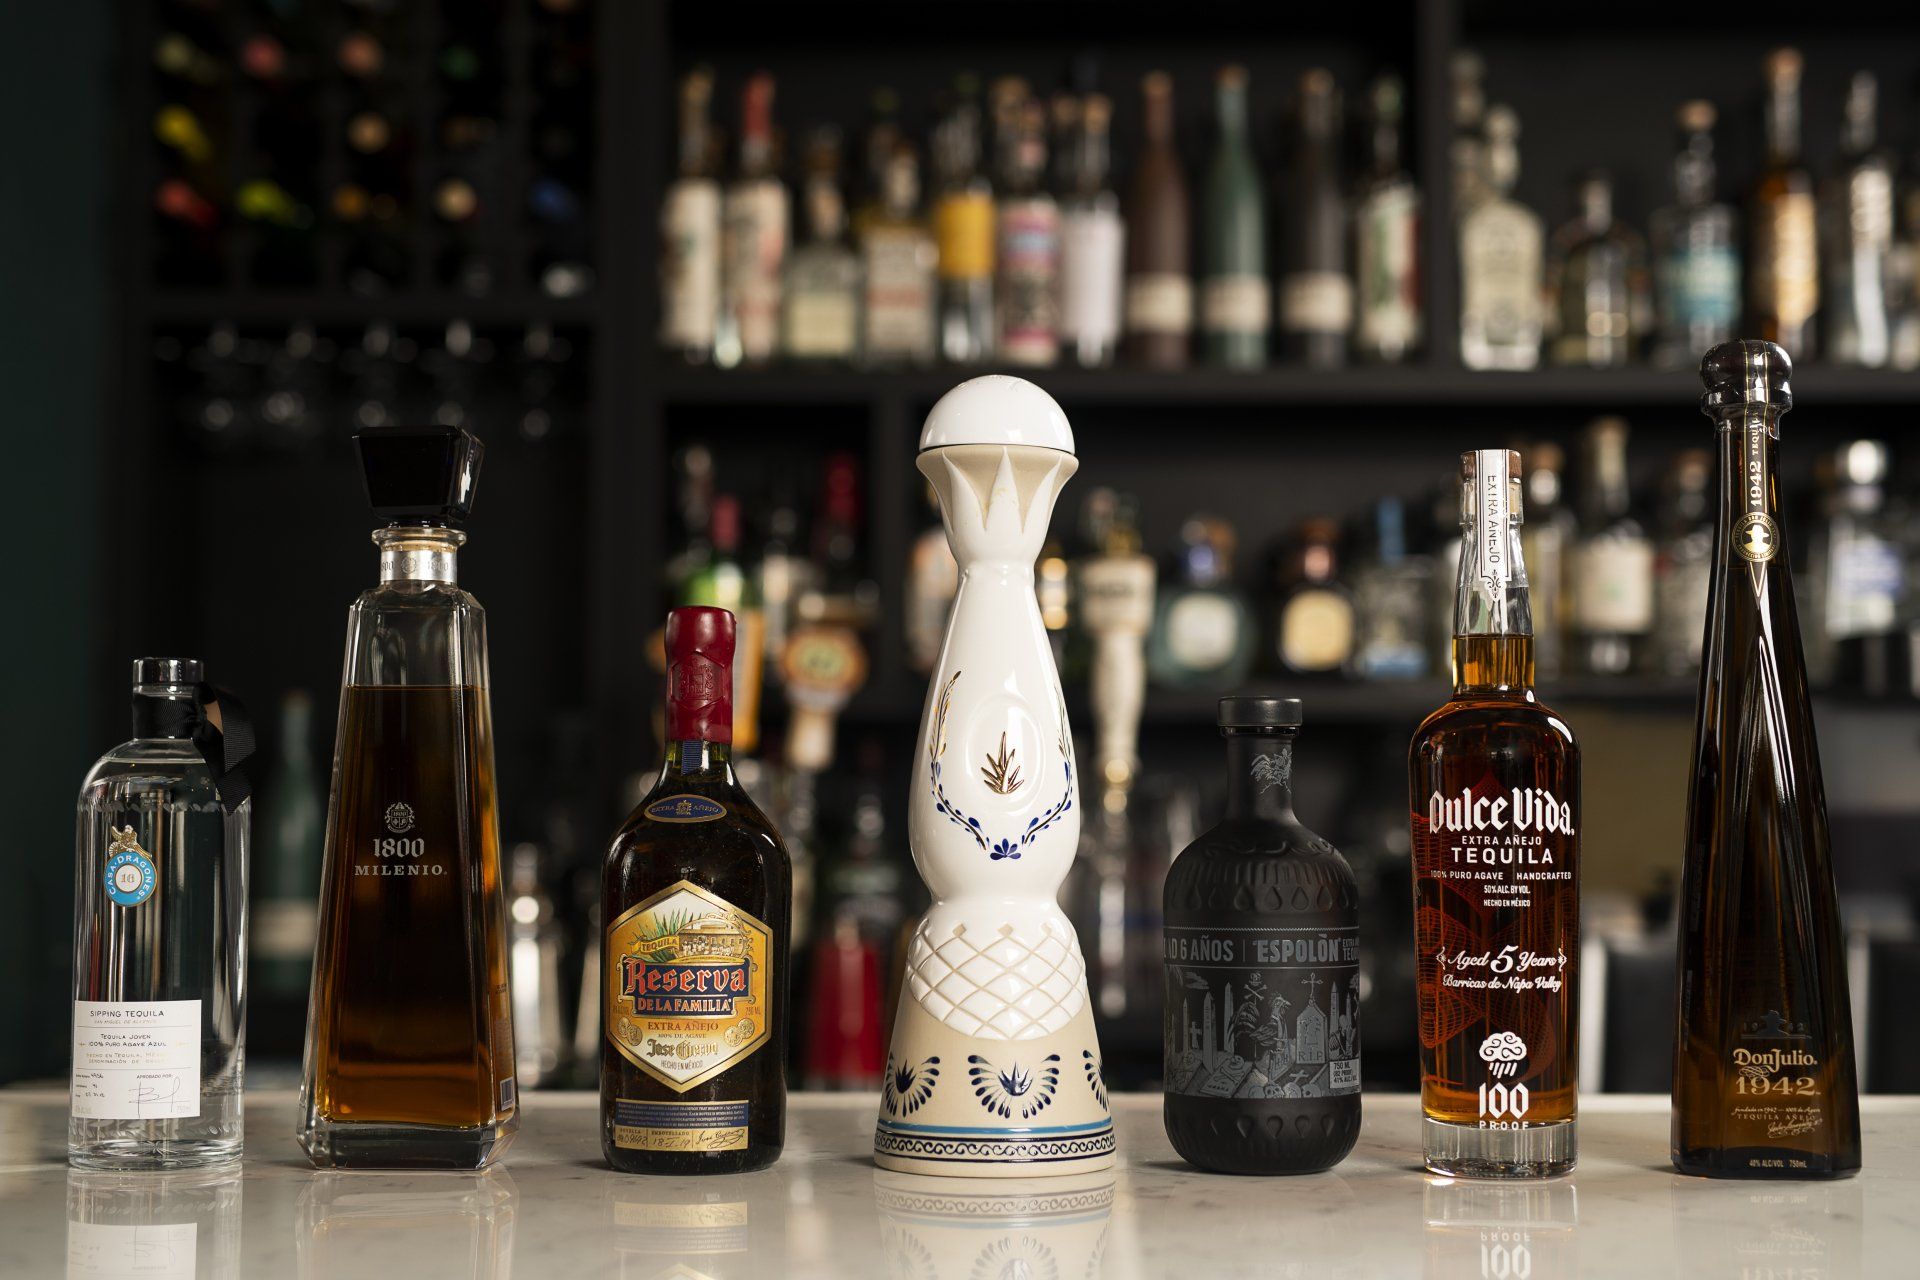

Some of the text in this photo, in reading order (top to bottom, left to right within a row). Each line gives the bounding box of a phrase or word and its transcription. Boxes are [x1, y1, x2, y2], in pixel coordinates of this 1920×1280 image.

[1750, 461, 1762, 507] 1942
[1487, 475, 1502, 564] EXTRA AÑEJO
[1430, 786, 1509, 835] Dulce
[372, 838, 425, 858] 1800
[1461, 834, 1542, 846] EXTRA AÑEJO
[1451, 847, 1554, 866] TEQUILA
[107, 855, 153, 897] CASA DRAGONES
[354, 864, 443, 876] MILENIO
[1450, 870, 1472, 880] PURO
[1474, 871, 1504, 880] AGAVE
[1516, 871, 1572, 880] HANDCRAFTED
[1483, 885, 1496, 894] 50%
[1510, 885, 1518, 894] BY
[1483, 899, 1502, 907] HECHO
[1502, 899, 1510, 907] EN
[641, 938, 678, 952] TEQUILA
[1180, 937, 1187, 960] 6
[1190, 934, 1234, 962] AÑOS
[1447, 945, 1557, 973] Aged 5 Years
[623, 957, 747, 996] Reserva
[1442, 974, 1487, 989] Barricas
[1487, 975, 1501, 988] de
[1501, 976, 1534, 994] Napa
[90, 1010, 165, 1018] SIPPING TEQUILA
[637, 998, 655, 1011] DE
[655, 998, 672, 1012] LA
[674, 998, 732, 1012] FAMILIA
[647, 1020, 719, 1031] EXTRA AÑEJO
[660, 1059, 677, 1070] HECHO
[677, 1061, 685, 1070] EN
[1734, 1076, 1816, 1096] 1942
[1479, 1081, 1529, 1119] 100
[1479, 1121, 1529, 1131] PROOF
